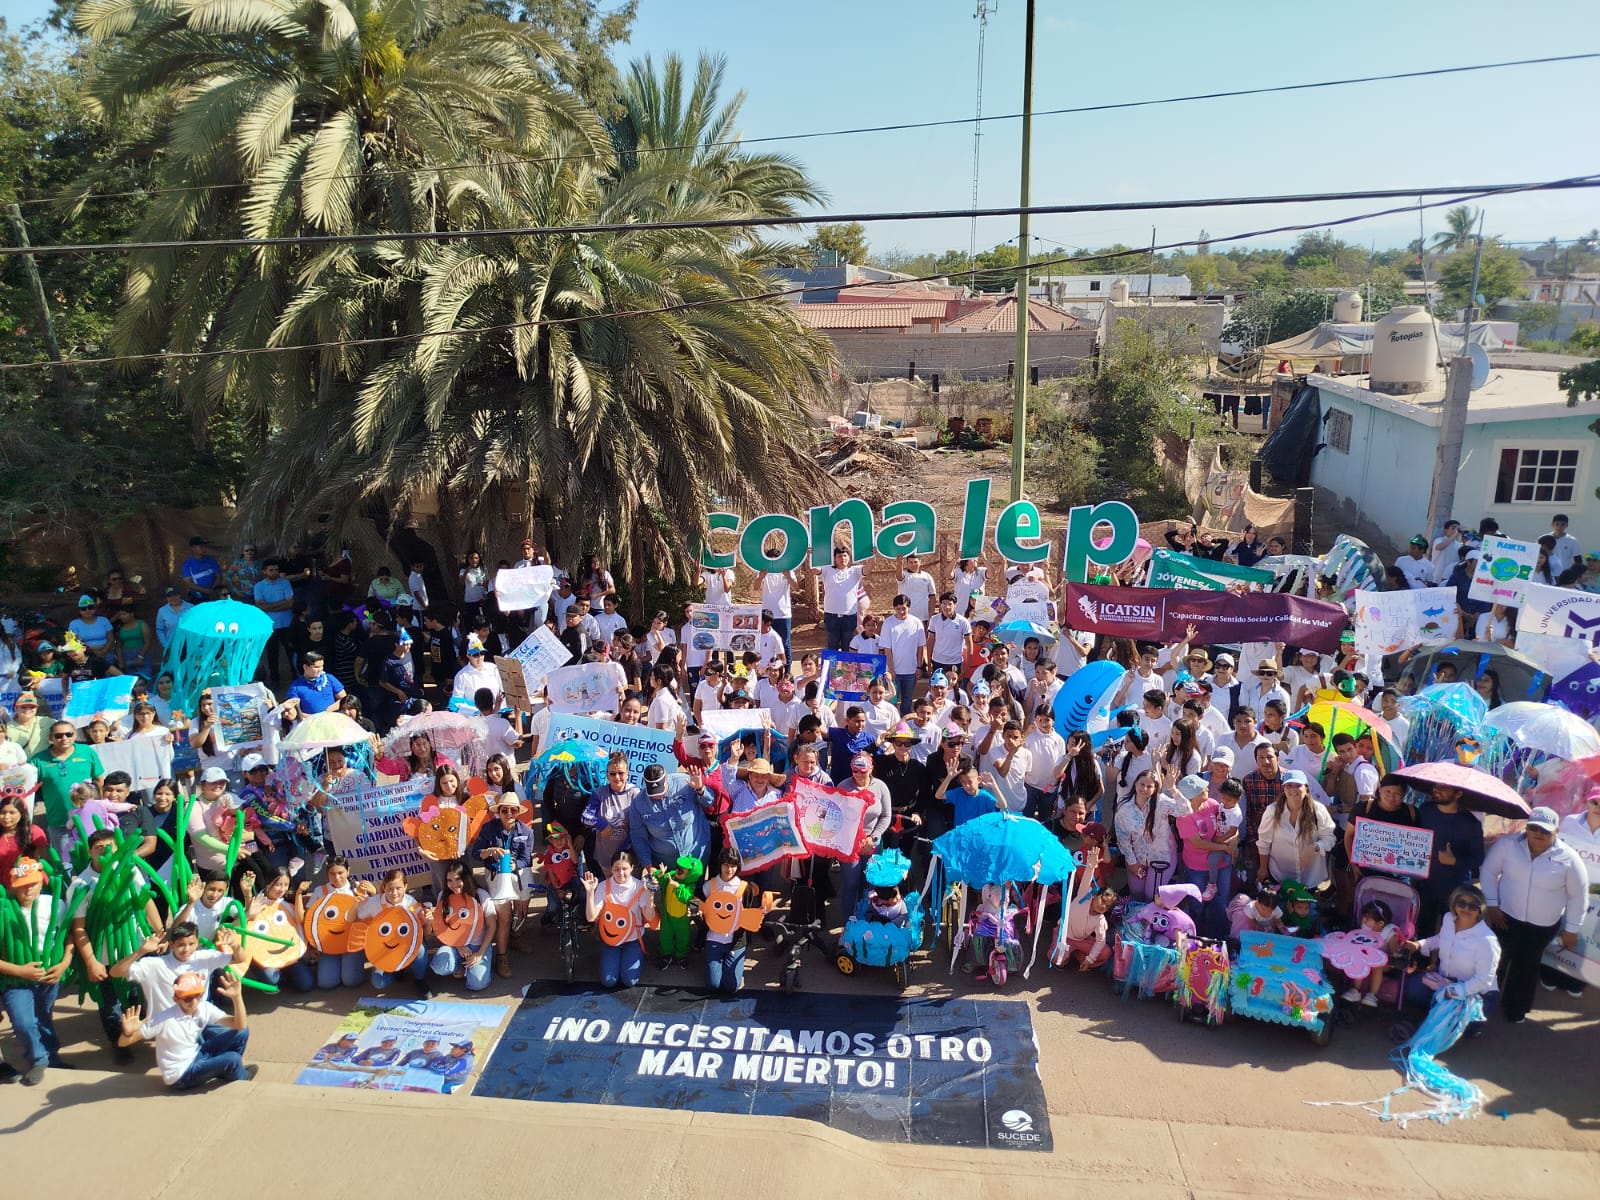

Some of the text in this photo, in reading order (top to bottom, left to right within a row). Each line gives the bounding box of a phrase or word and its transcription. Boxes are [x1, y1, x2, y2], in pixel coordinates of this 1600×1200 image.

[1391, 331, 1423, 343] Rotoplas
[696, 477, 1139, 583] conalep
[1100, 603, 1156, 617] ICATSIN
[1541, 596, 1592, 628] UNIVERSIDAD
[1206, 614, 1219, 622] con
[1220, 614, 1246, 623] Sentido
[1247, 615, 1268, 623] Social
[1275, 614, 1301, 623] Calidad
[1302, 615, 1311, 624] de
[581, 729, 673, 754] NO QUEREMOS
[355, 843, 388, 857] BAHIA
[1412, 850, 1431, 860] Vida
[368, 851, 423, 869] TE INVITAN
[543, 1016, 993, 1063] ¡NO NECESITAMOS OTRO
[637, 1049, 896, 1088] MAR MUERTO!
[997, 1132, 1041, 1142] SUCEDE
